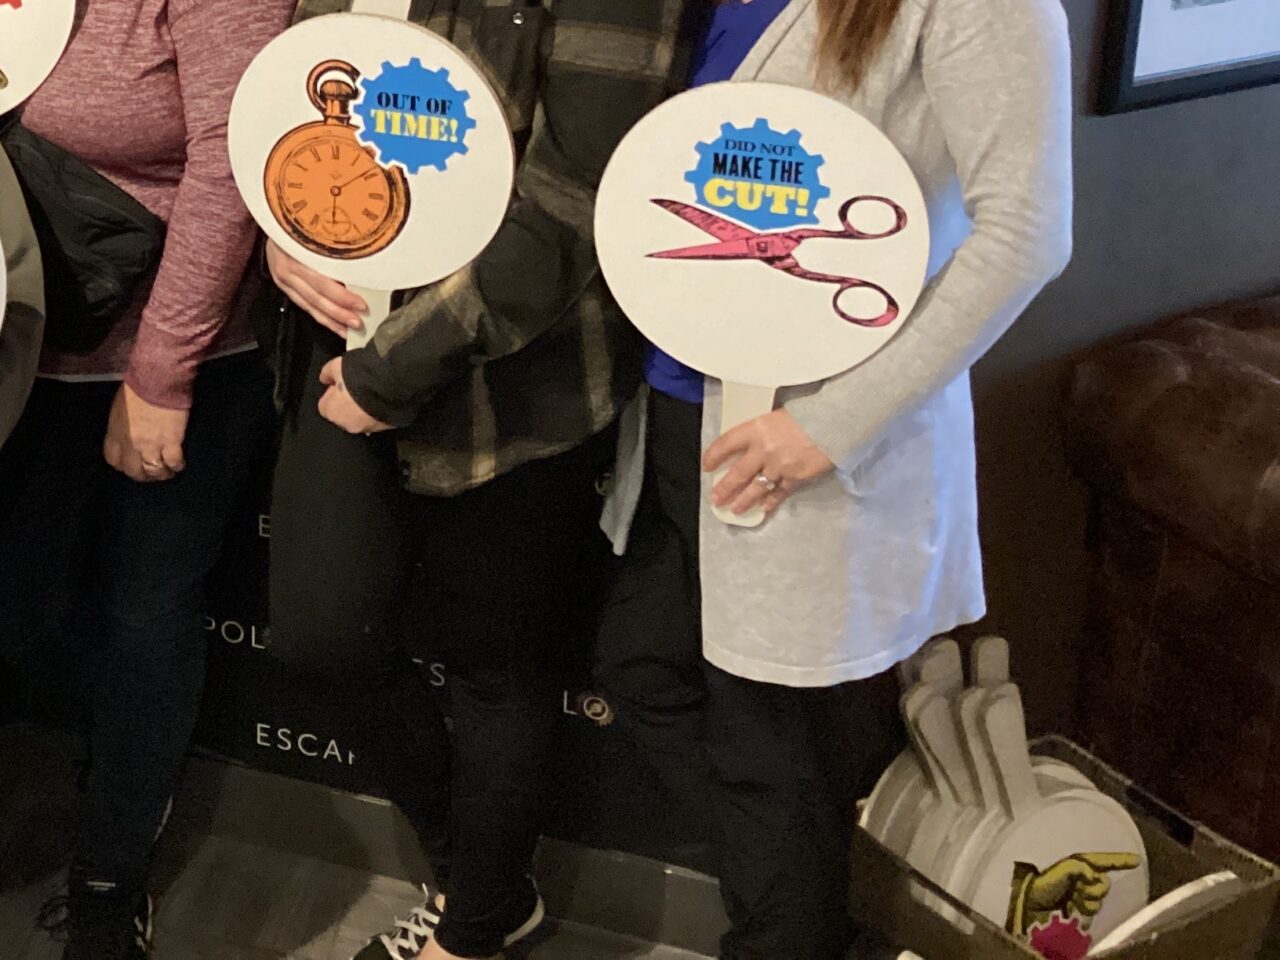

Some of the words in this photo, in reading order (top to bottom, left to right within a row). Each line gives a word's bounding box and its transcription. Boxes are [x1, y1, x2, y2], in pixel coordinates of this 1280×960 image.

[377, 91, 421, 112] OUT
[426, 97, 453, 116] OF
[370, 108, 459, 143] TIME!
[724, 138, 757, 153] DID
[759, 143, 796, 158] NOT
[712, 152, 764, 180] MAKE
[769, 158, 805, 185] THE
[703, 178, 811, 217] CUT!
